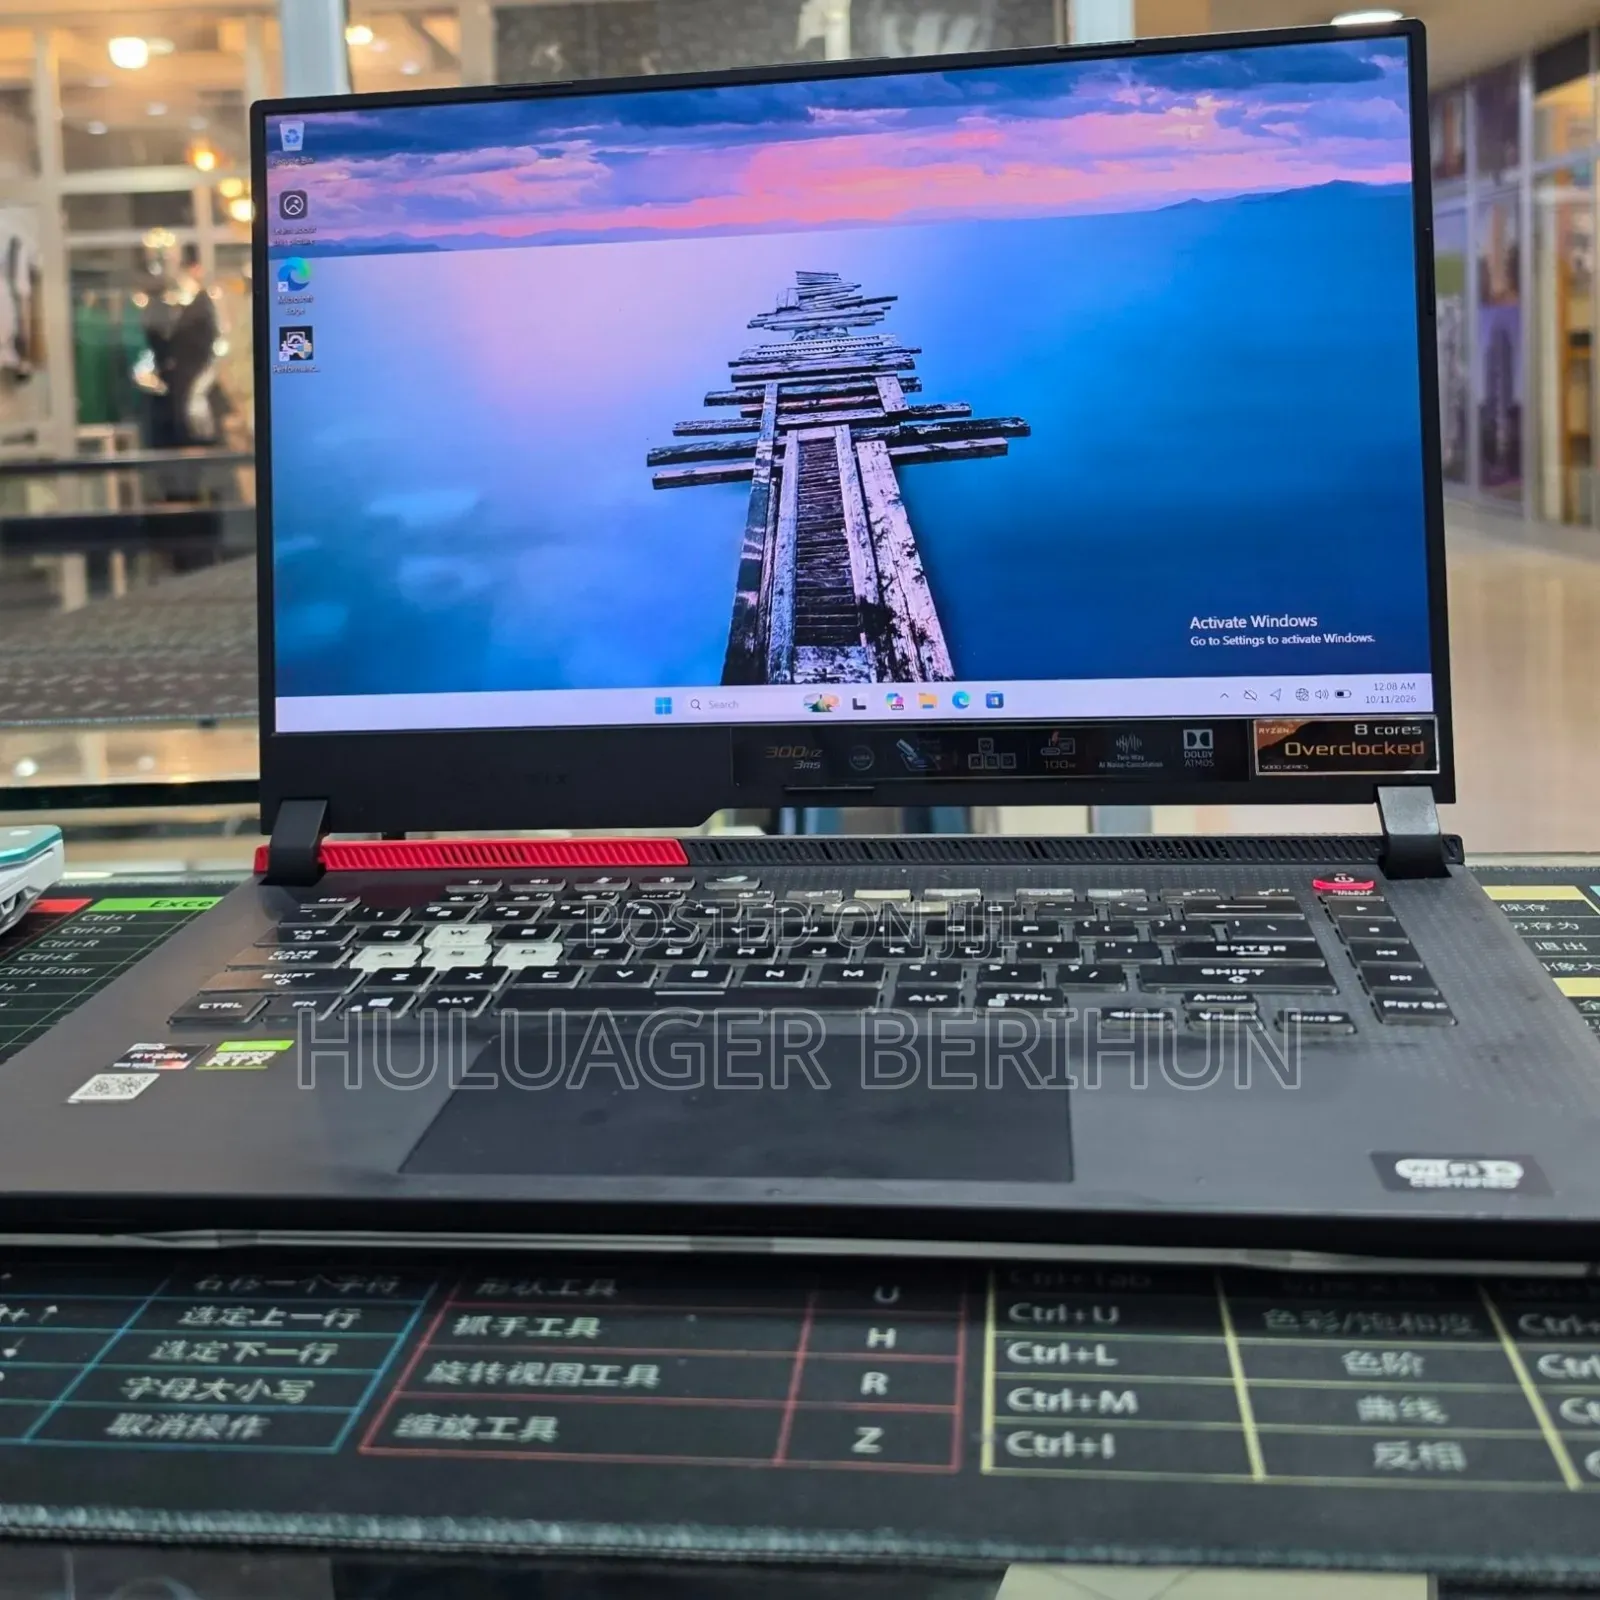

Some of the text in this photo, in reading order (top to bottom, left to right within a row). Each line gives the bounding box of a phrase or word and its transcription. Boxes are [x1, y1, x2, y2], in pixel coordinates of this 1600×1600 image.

[1190, 615, 1318, 629] Activate Windows
[1190, 633, 1376, 647] Go to Settings to activate Windows.
[1400, 682, 1416, 690] AM
[708, 699, 739, 709] Search
[1354, 724, 1422, 735] 8 cores
[1284, 740, 1425, 757] Overclocked
[1184, 759, 1215, 767] ATMOS
[262, 972, 315, 980] SHIFT
[465, 972, 483, 980] X
[616, 970, 634, 978] V
[765, 970, 785, 978] N
[842, 969, 864, 977] M
[437, 996, 474, 1004] ALT
[873, 1286, 898, 1303] U
[178, 1306, 361, 1329] 选定上一行
[1008, 1302, 1119, 1325] Ctrl+U
[453, 1314, 602, 1339] 抓手工具
[866, 1327, 897, 1348] H
[149, 1340, 339, 1365] 选定下一行
[1006, 1340, 1119, 1366] Ctrl+L
[424, 1360, 661, 1389] 旋转视图工具
[121, 1376, 315, 1404] 字母大小写
[861, 1371, 889, 1396] R
[1006, 1387, 1139, 1414] Ctrl+M
[106, 1412, 271, 1440] 取消操作
[394, 1413, 559, 1443] 缩放工具
[852, 1427, 884, 1454] Z
